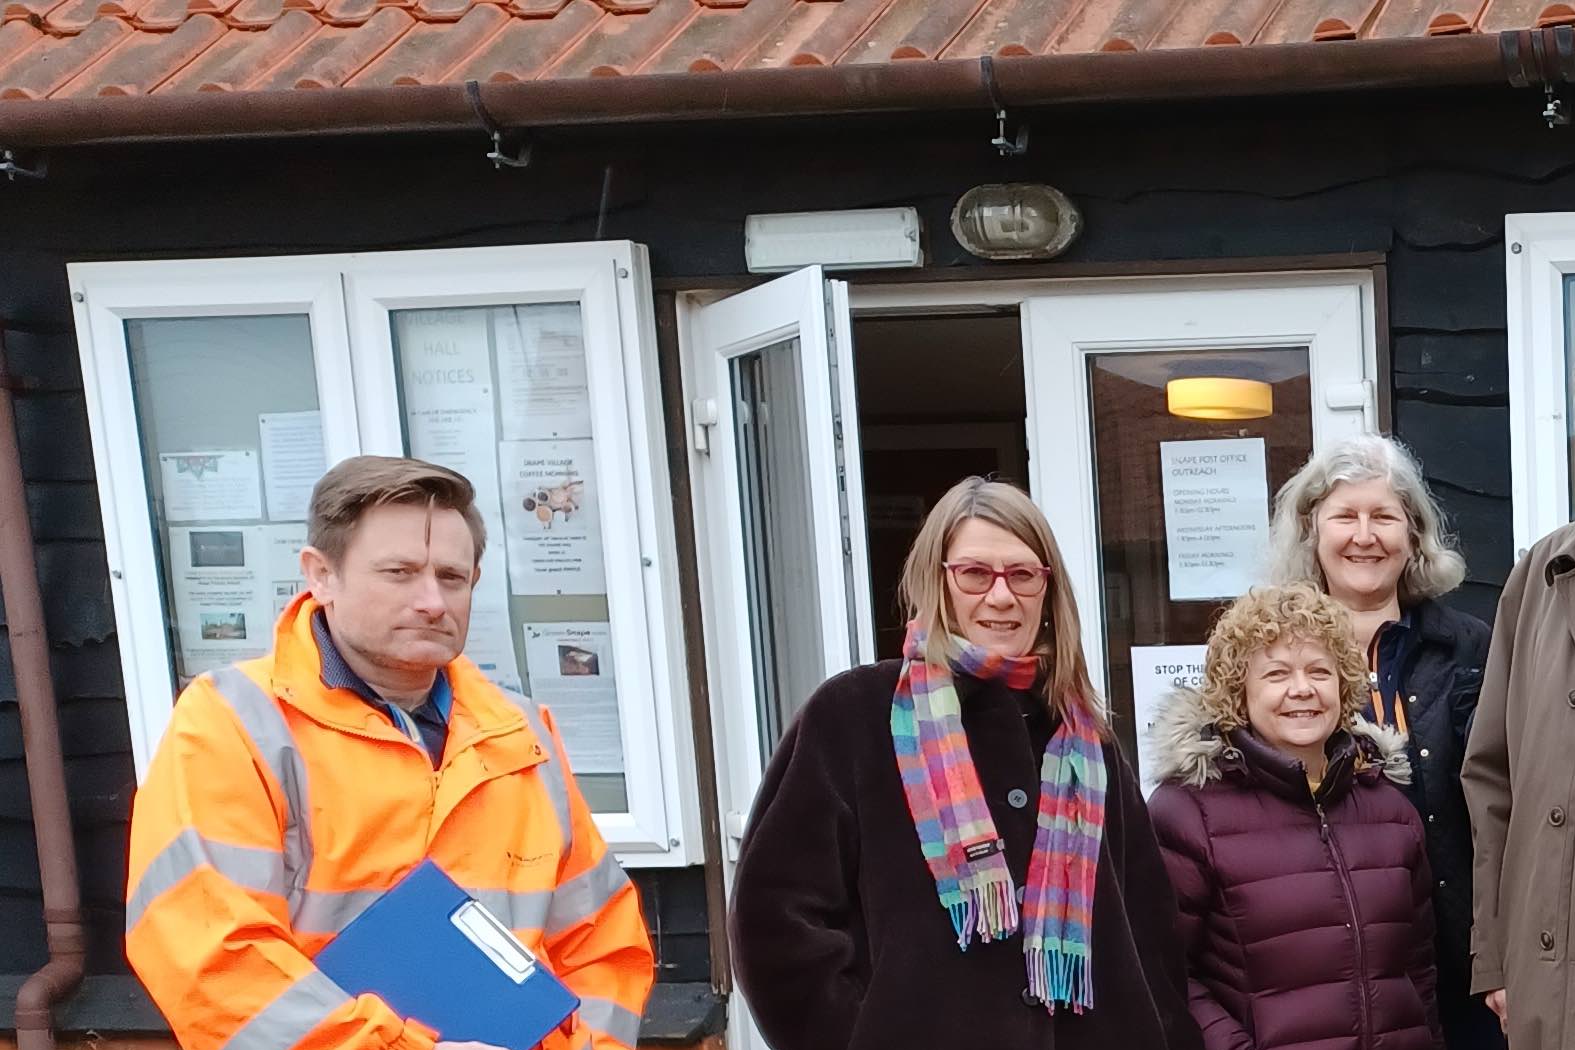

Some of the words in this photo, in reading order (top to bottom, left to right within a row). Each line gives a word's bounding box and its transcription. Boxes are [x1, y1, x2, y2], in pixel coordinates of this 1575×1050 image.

[423, 341, 461, 356] HALL
[411, 369, 474, 384] NOTICES
[1199, 455, 1218, 464] POST
[1220, 454, 1247, 464] OFFICE
[1171, 467, 1217, 476] OUTREACH
[1155, 664, 1183, 675] STOP
[1173, 677, 1187, 687] OF
